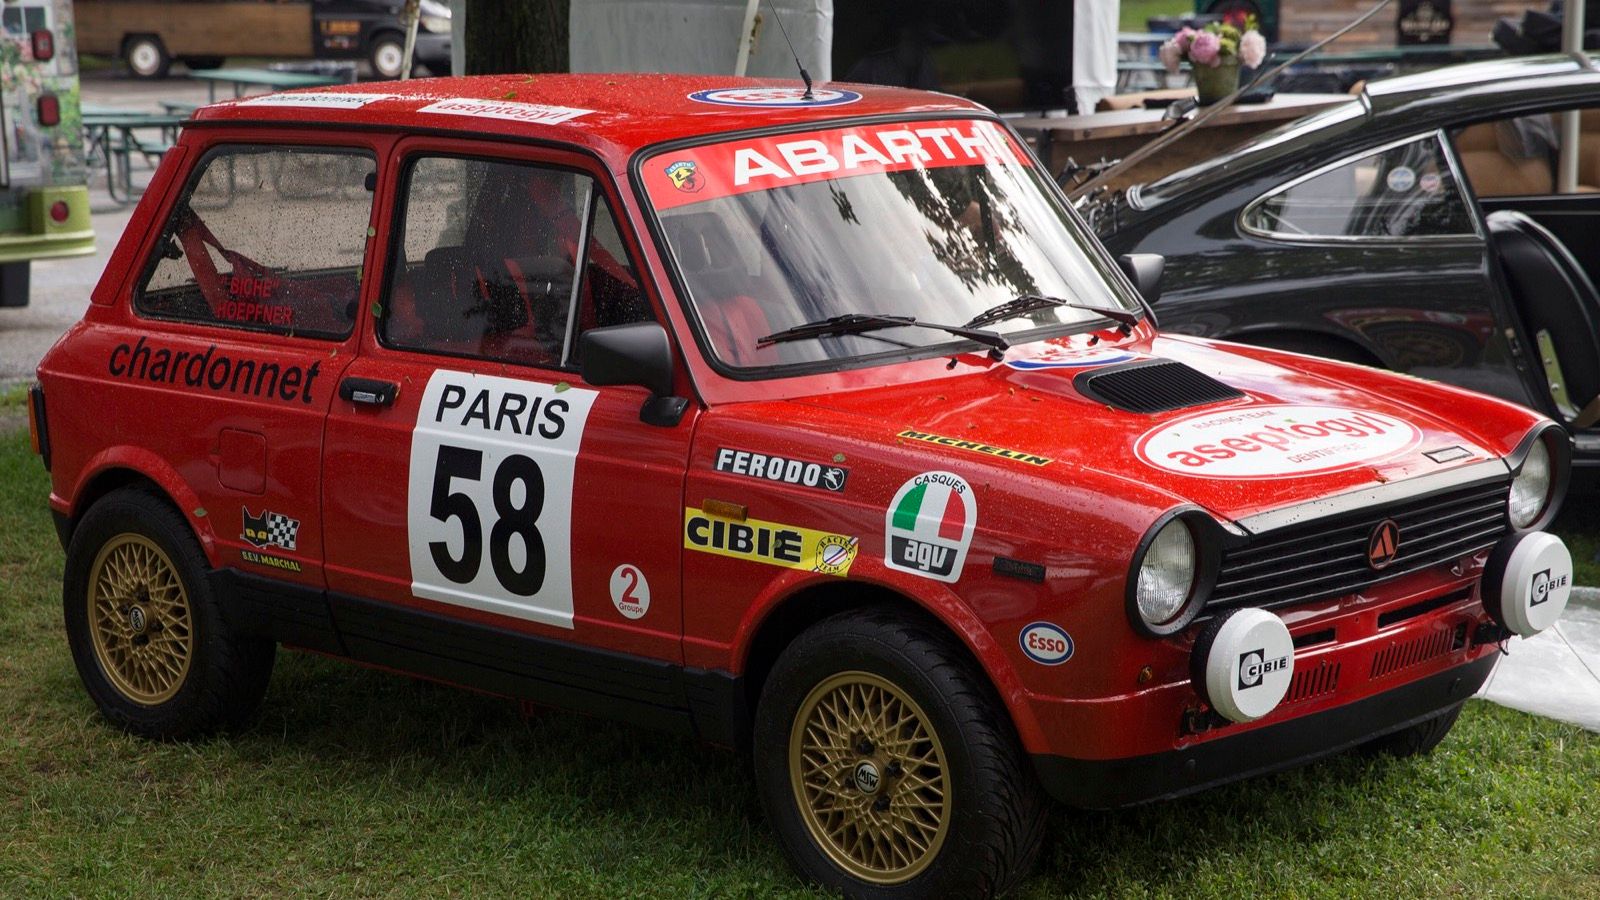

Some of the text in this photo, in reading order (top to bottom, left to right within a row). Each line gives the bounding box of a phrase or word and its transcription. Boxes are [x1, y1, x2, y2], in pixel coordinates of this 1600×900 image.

[733, 126, 1003, 187] ABARTH
[215, 300, 295, 325] HOEPFNER
[109, 336, 322, 403] chardonnet
[435, 384, 570, 440] PARIS
[901, 431, 1050, 466] MICHELIN
[1167, 411, 1396, 467] aseptogyl
[716, 448, 821, 487] FERODO
[914, 474, 966, 495] CASQUES
[428, 444, 547, 597] 58
[260, 554, 302, 572] MARCHAL
[820, 562, 841, 572] TEAM
[904, 540, 949, 572] agv
[620, 567, 640, 605] 2
[618, 602, 644, 614] Groupe
[1028, 632, 1066, 654] Esso
[857, 768, 880, 789] MSW
